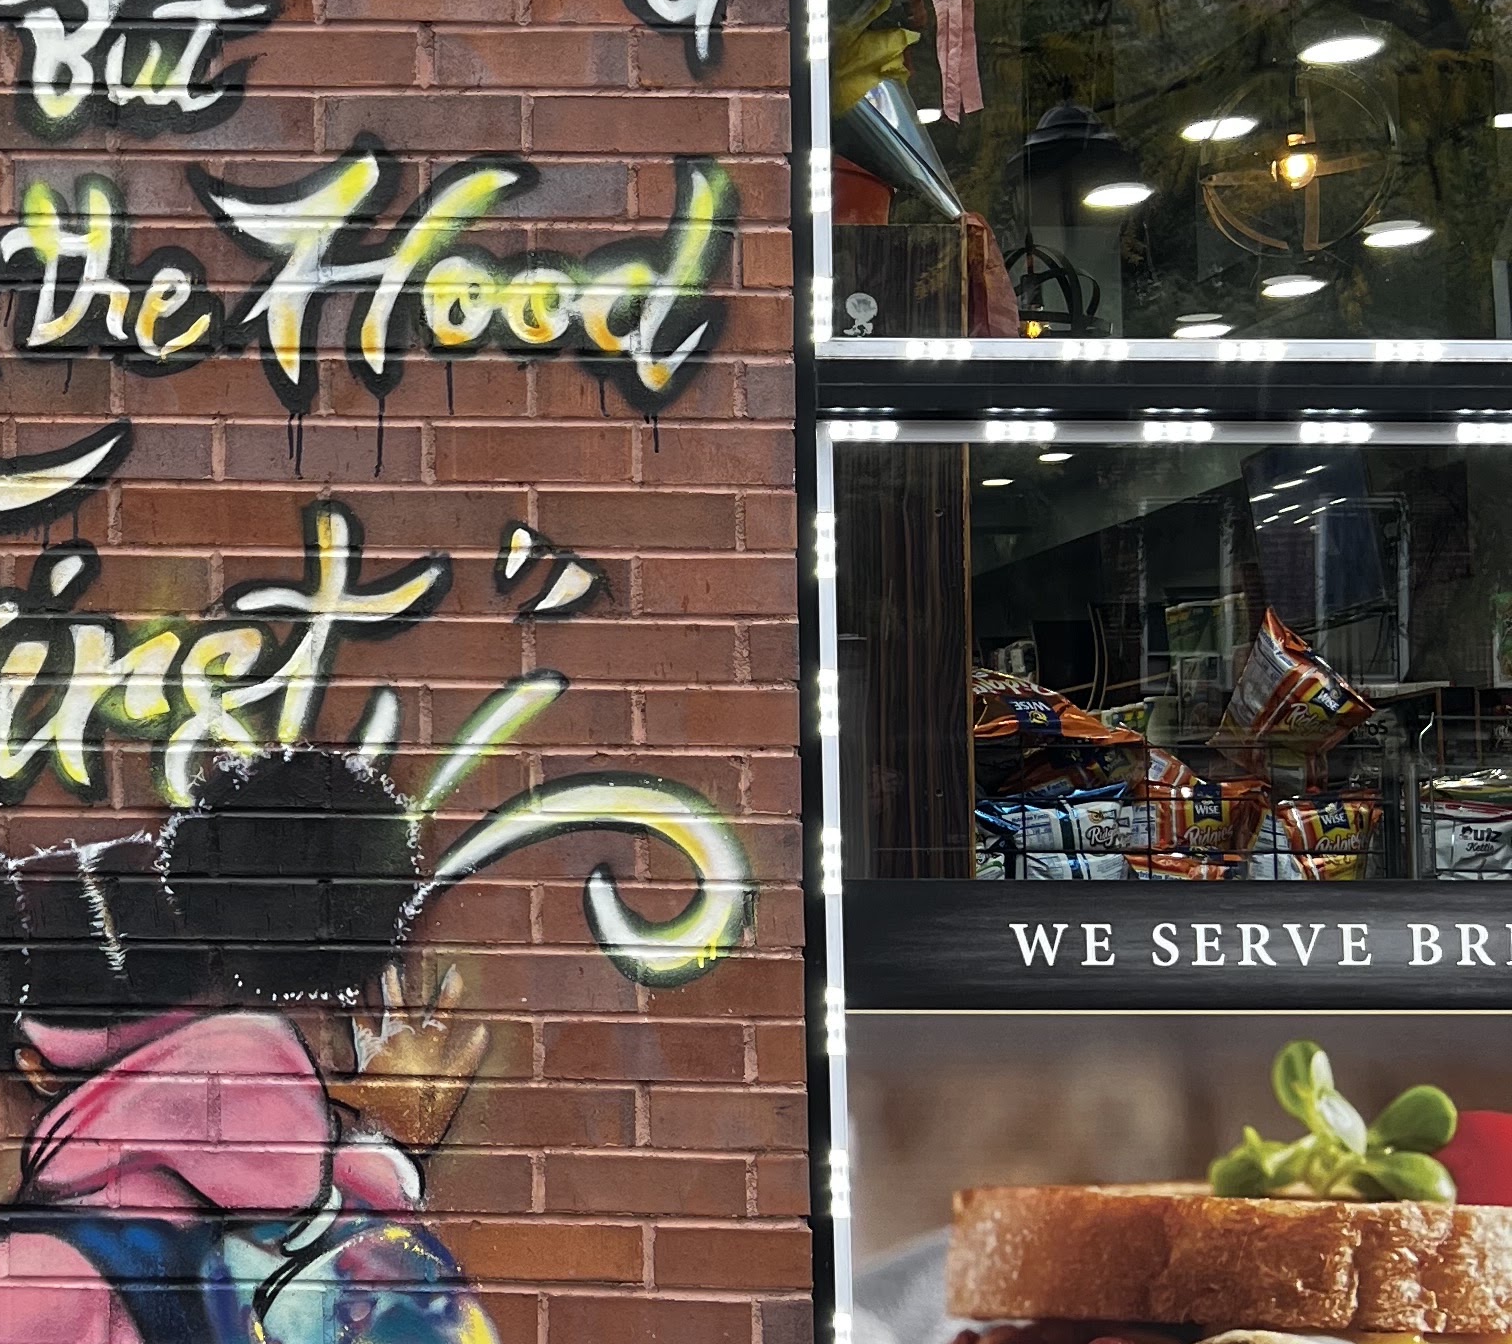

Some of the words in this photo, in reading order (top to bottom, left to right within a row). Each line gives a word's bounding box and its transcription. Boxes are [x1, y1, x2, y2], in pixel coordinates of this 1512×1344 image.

[0, 174, 216, 362] the
[204, 146, 733, 393] Hood
[1009, 922, 1116, 967] WE
[1151, 921, 1372, 967] SERVE
[1406, 922, 1512, 967] BR
